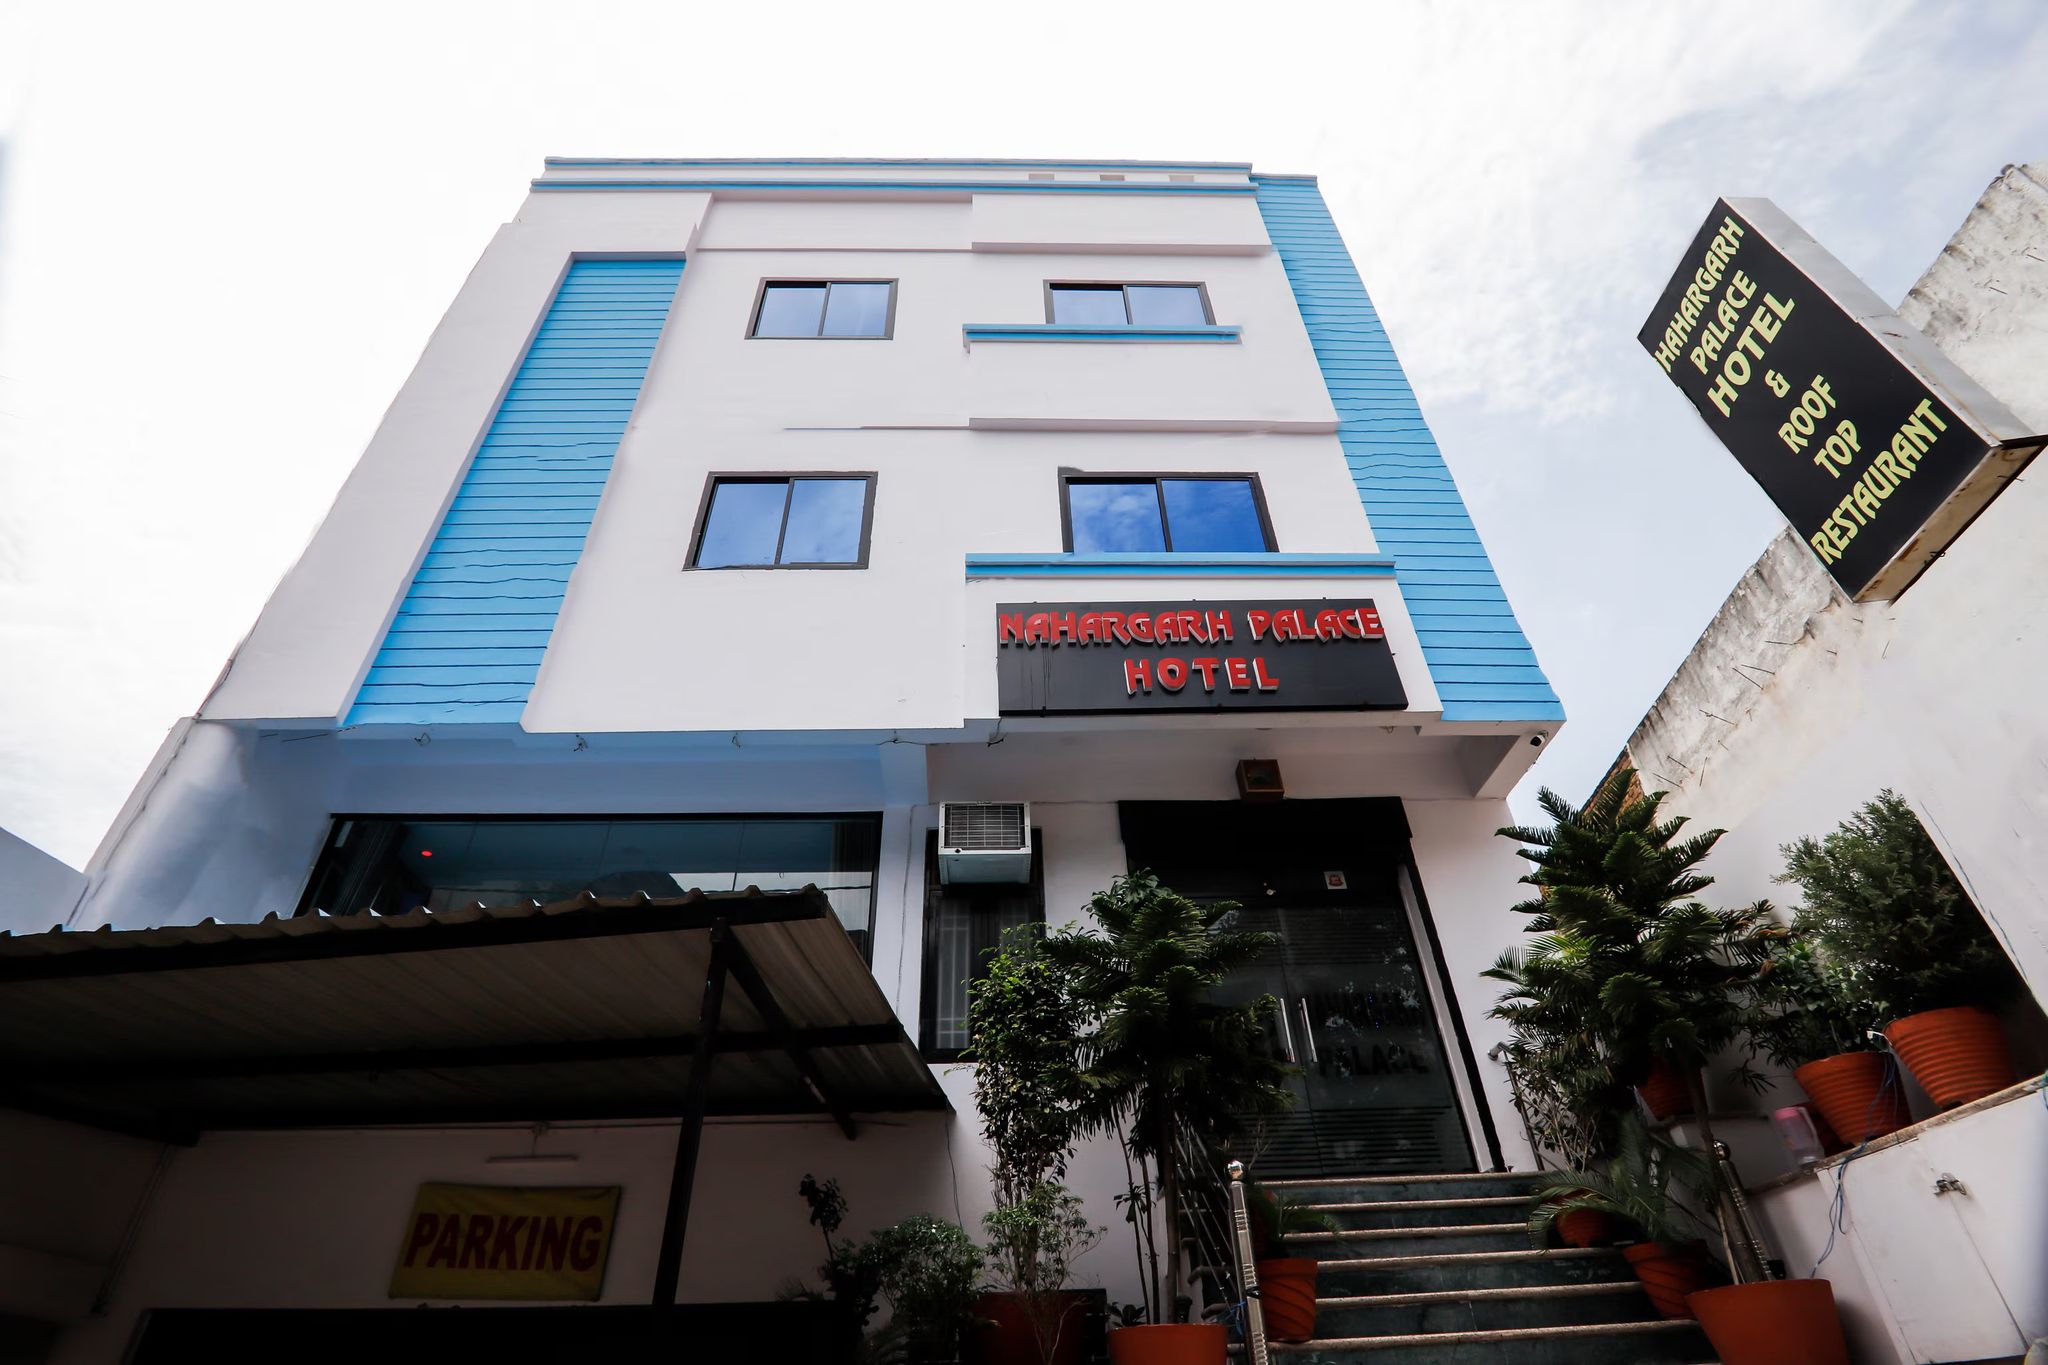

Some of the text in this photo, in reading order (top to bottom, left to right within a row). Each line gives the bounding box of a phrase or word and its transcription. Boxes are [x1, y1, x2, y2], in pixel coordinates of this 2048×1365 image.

[1690, 270, 1758, 375] PALACE
[1706, 292, 1796, 418] HOTEL
[1764, 369, 1791, 399] &
[1778, 374, 1836, 454] ROOF
[1814, 419, 1862, 479] TOP
[1810, 398, 1948, 565] RESTAURANT
[1000, 608, 1385, 646] NAHARGARH PALACE
[1124, 657, 1280, 696] HOTEL
[403, 1213, 603, 1272] PARKING
